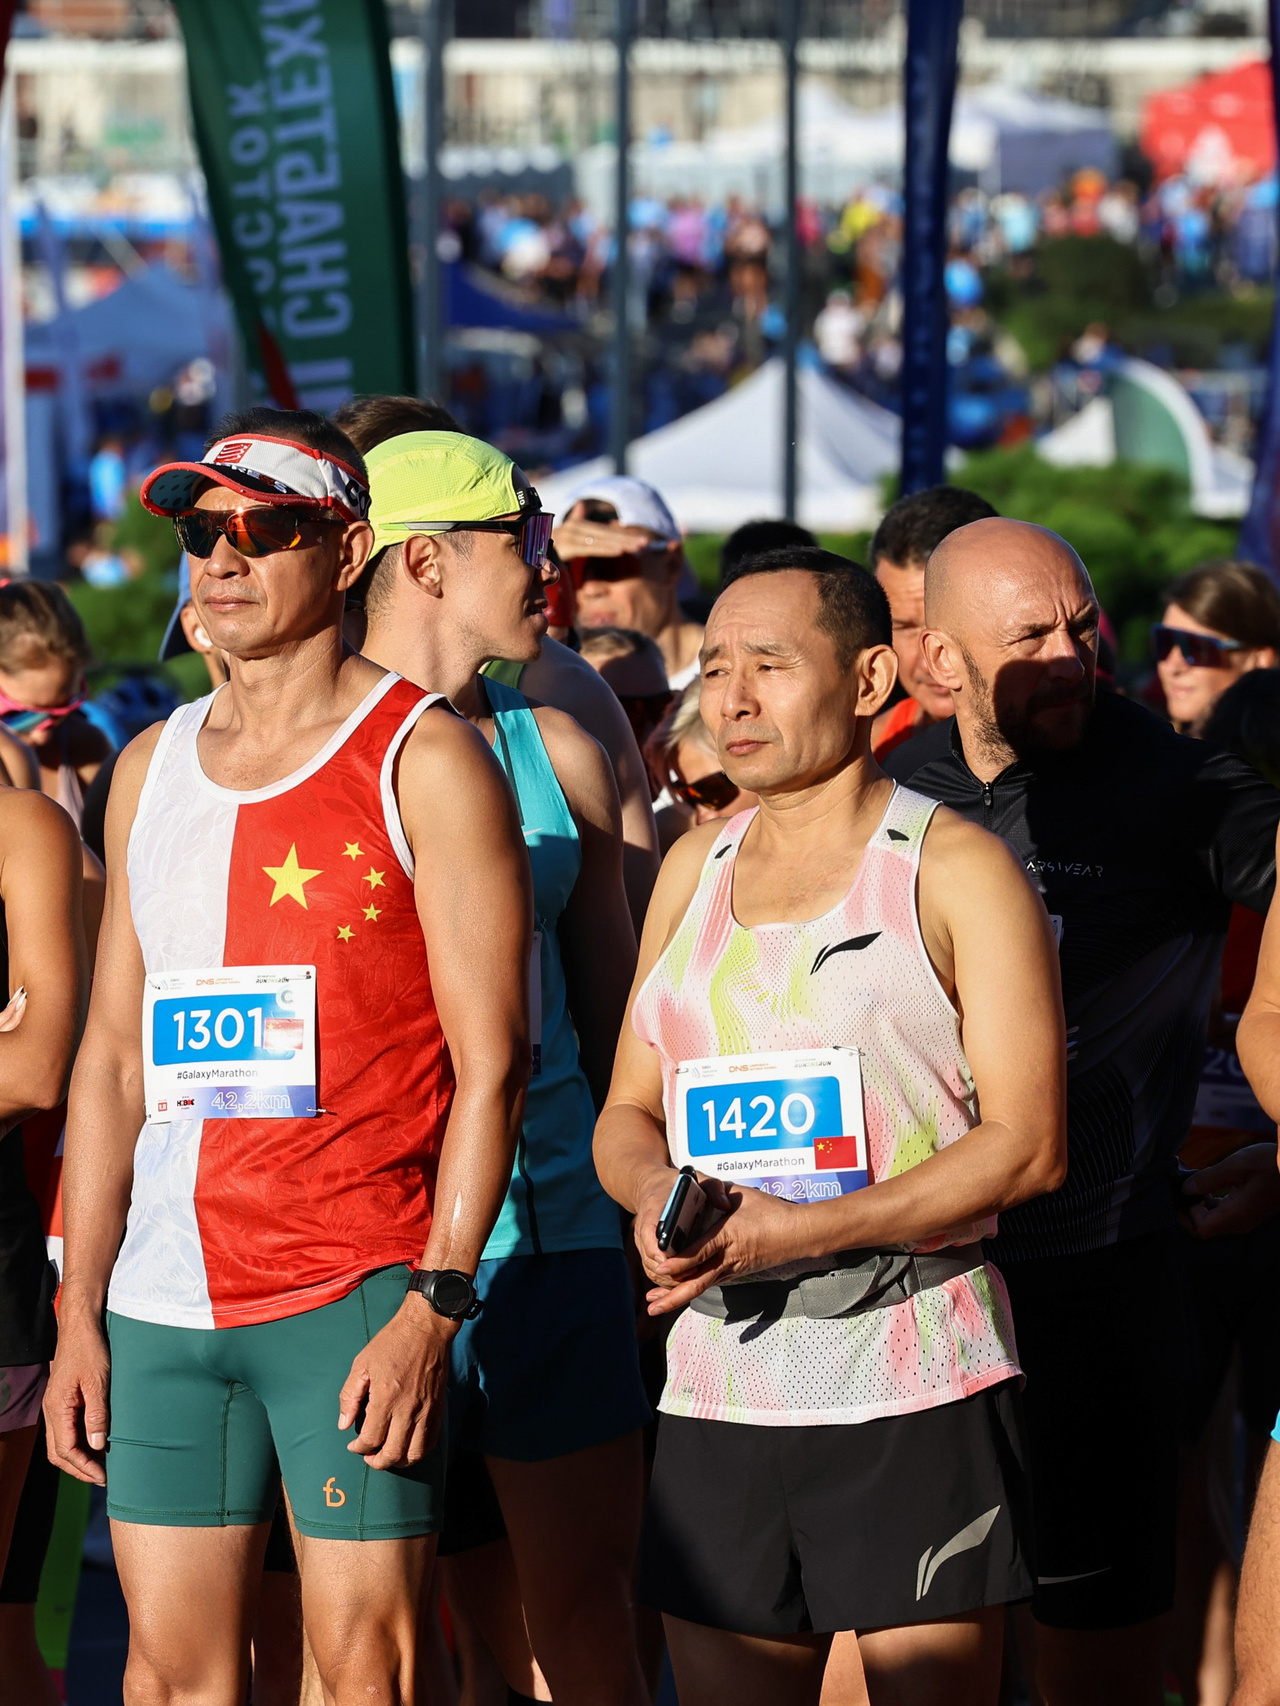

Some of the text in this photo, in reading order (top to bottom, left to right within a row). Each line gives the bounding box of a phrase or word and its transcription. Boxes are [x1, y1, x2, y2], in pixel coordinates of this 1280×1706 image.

[173, 1007, 263, 1051] 1301
[177, 1069, 259, 1080] #GalaxyMarathon
[728, 1064, 749, 1073] DNS
[211, 1091, 291, 1112] 42,2km
[701, 1092, 816, 1142] 1420
[717, 1157, 806, 1171] #GalaxyMarathon
